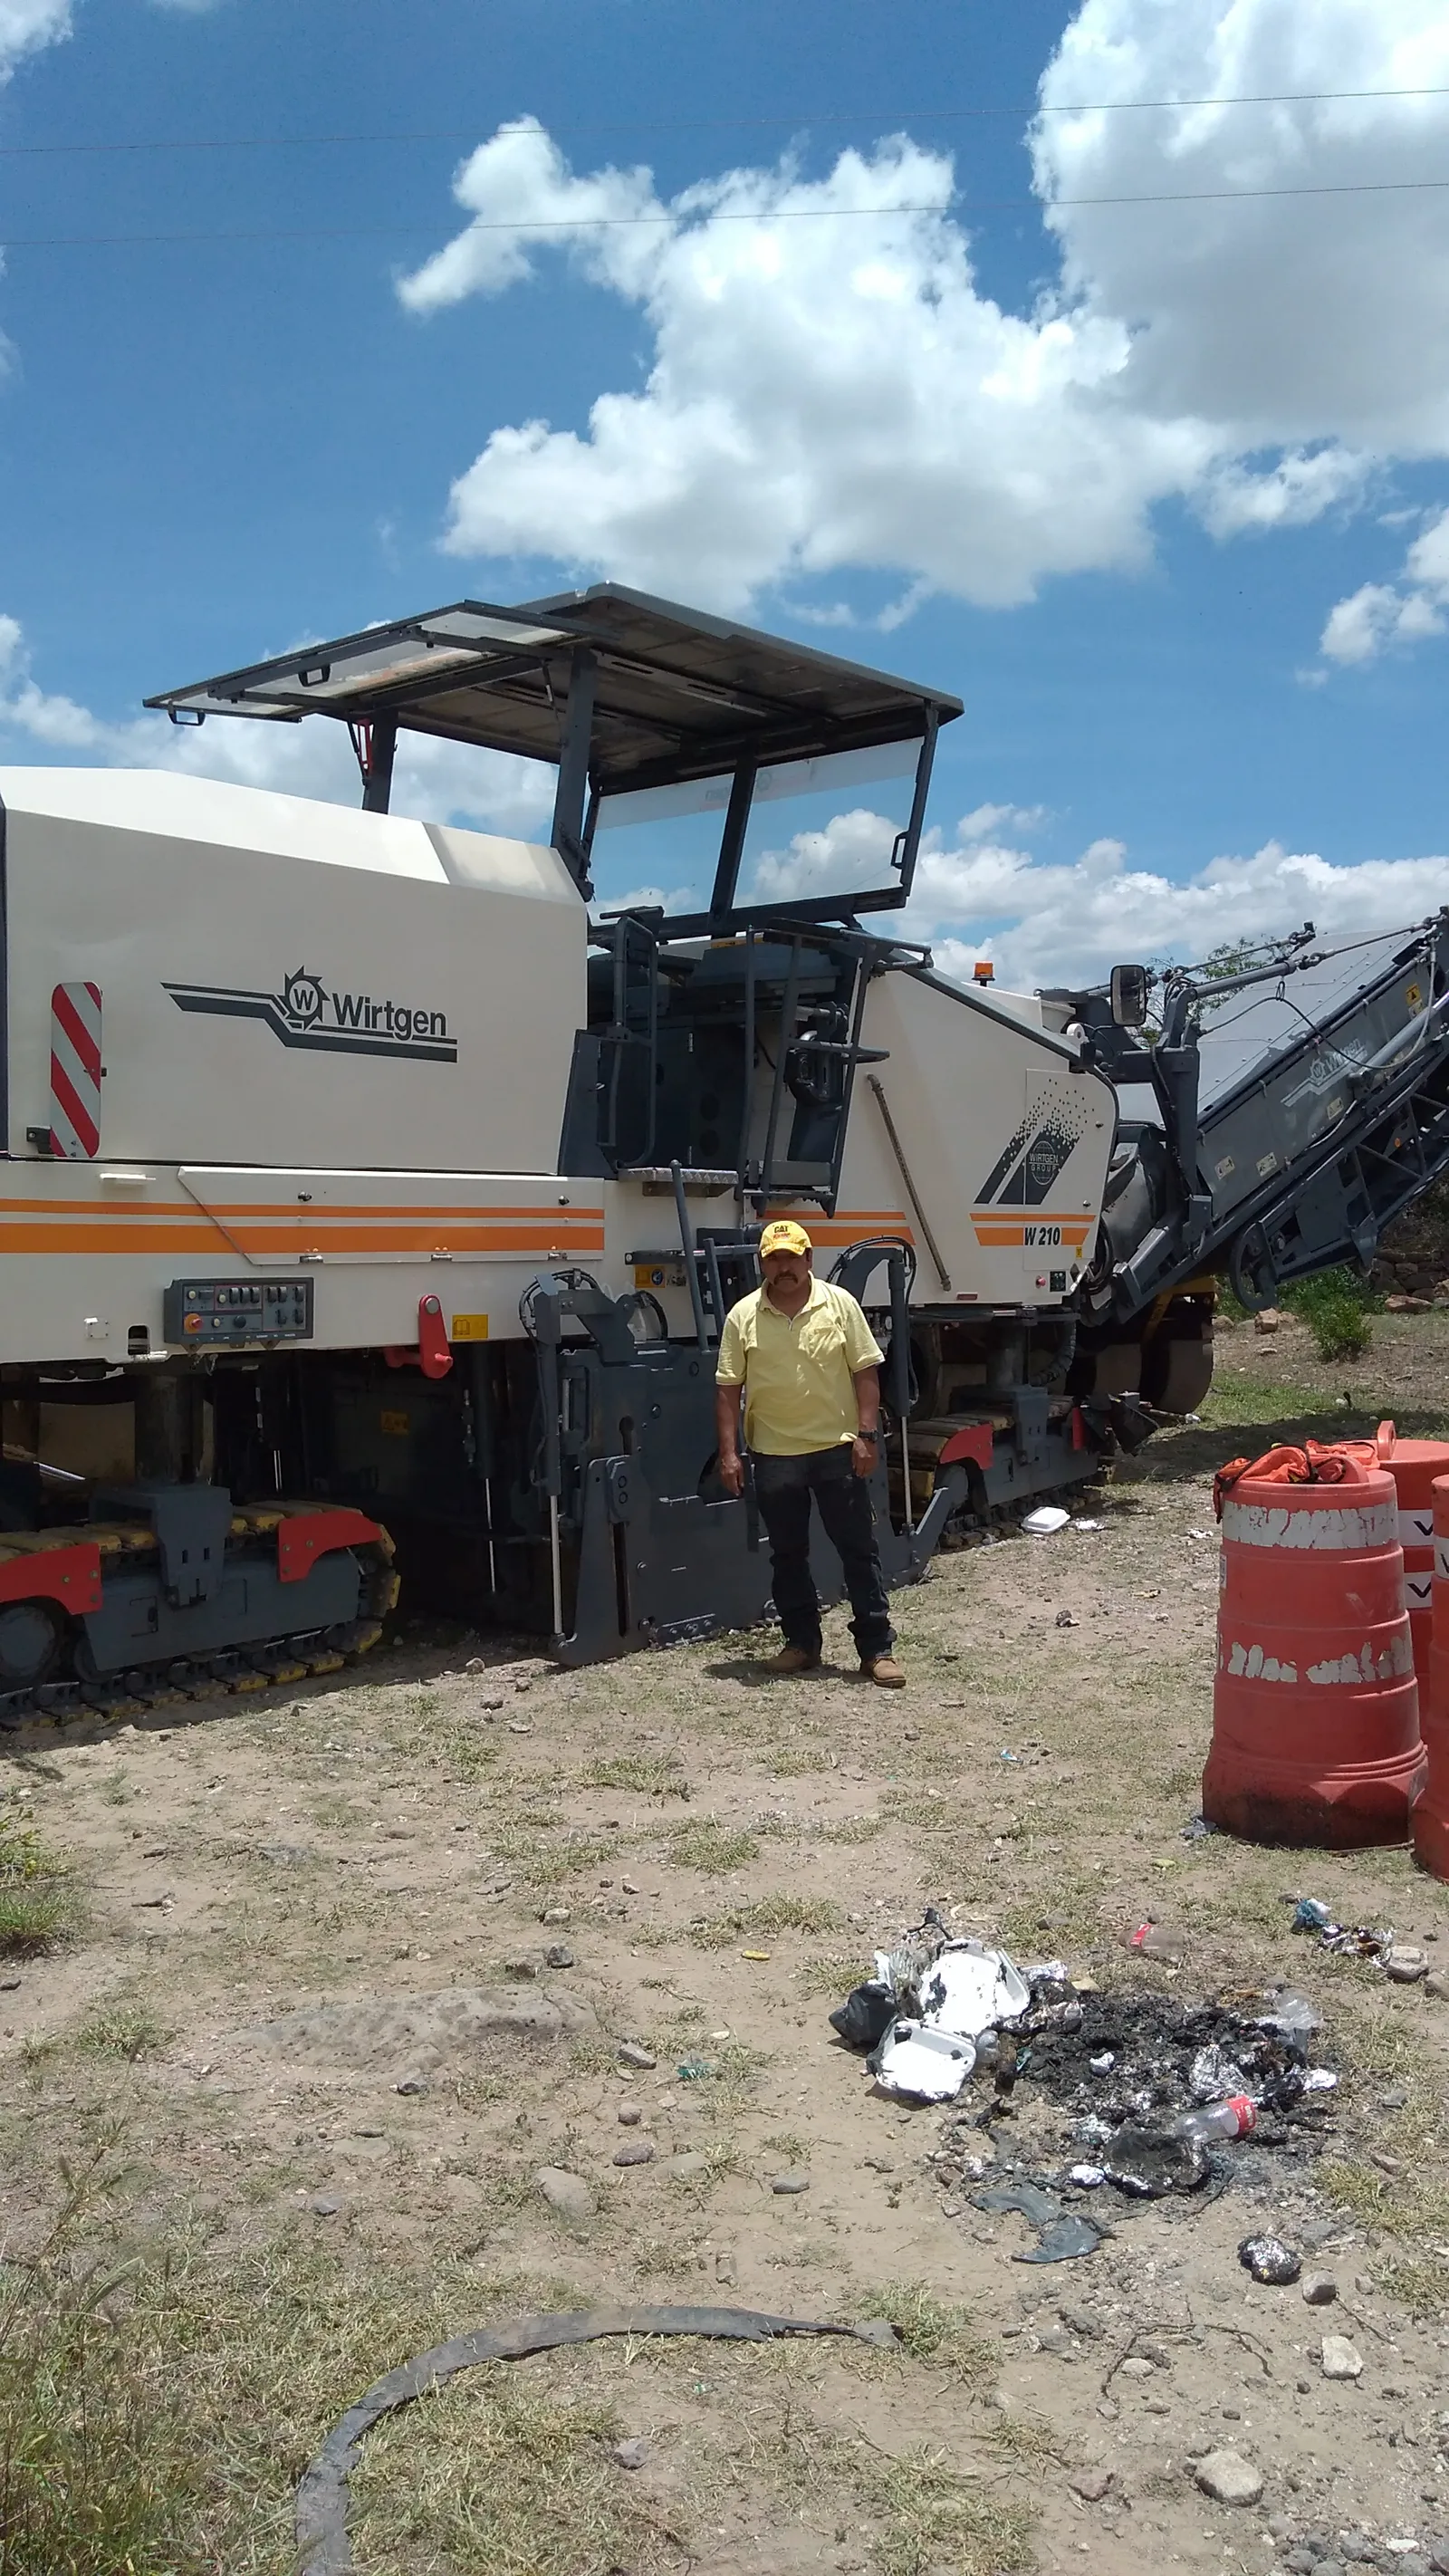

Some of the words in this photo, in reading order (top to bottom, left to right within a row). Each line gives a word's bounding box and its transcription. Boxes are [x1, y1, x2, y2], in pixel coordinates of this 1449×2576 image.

[293, 988, 314, 1011] W
[332, 993, 446, 1041] Wirtgen
[1029, 1153, 1059, 1163] WIRTGEN
[1031, 1164, 1057, 1172] GROUP
[774, 1226, 789, 1234] CAT
[1024, 1226, 1037, 1246] W
[1038, 1226, 1060, 1246] 210
